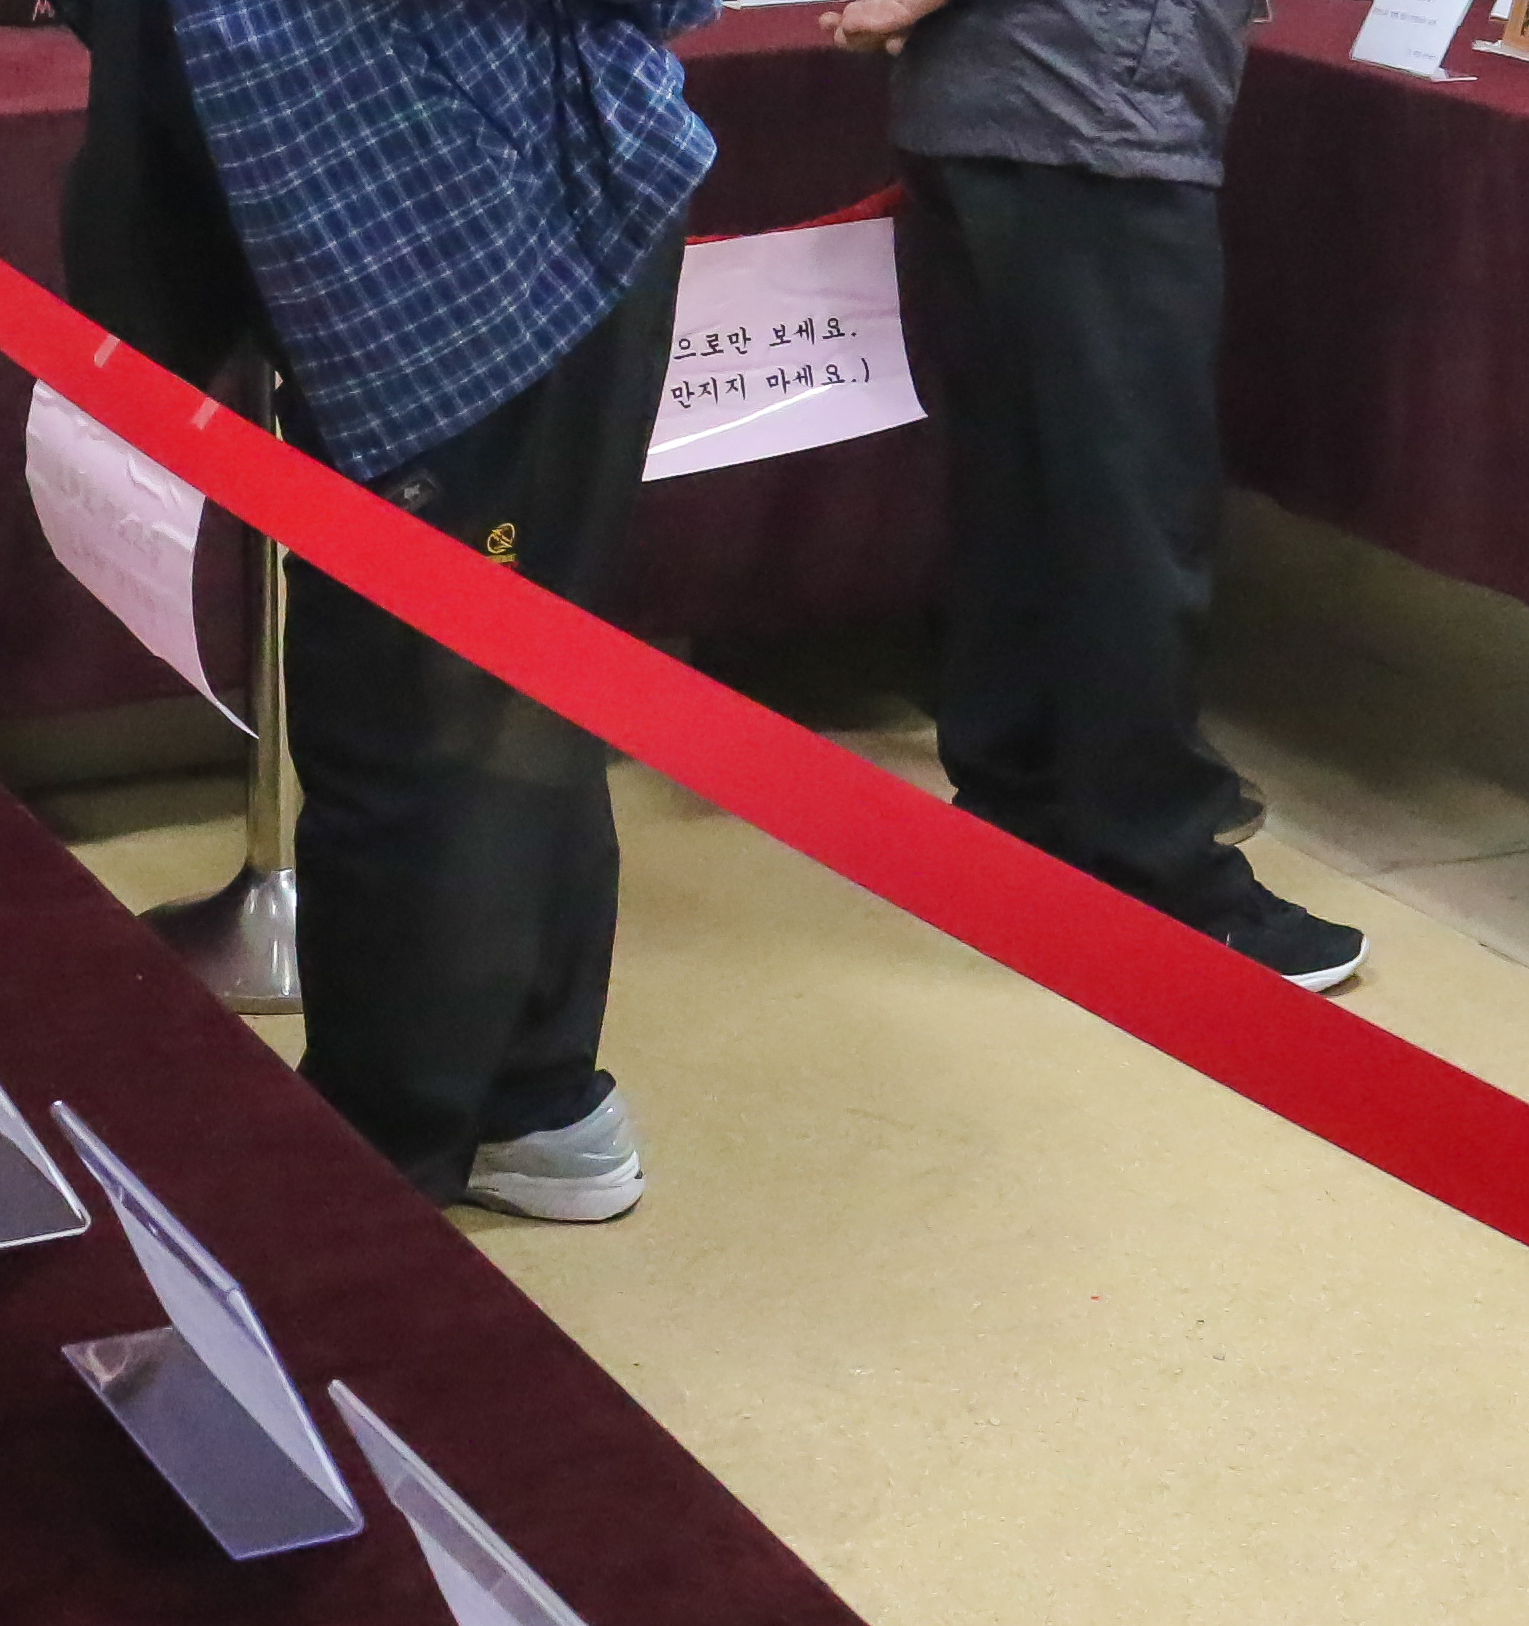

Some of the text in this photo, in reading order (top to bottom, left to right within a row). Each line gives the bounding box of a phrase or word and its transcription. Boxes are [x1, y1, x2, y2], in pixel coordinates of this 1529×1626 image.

[672, 316, 858, 360] 으로만 보세요.
[671, 357, 870, 409] 만지지 마세요.)
